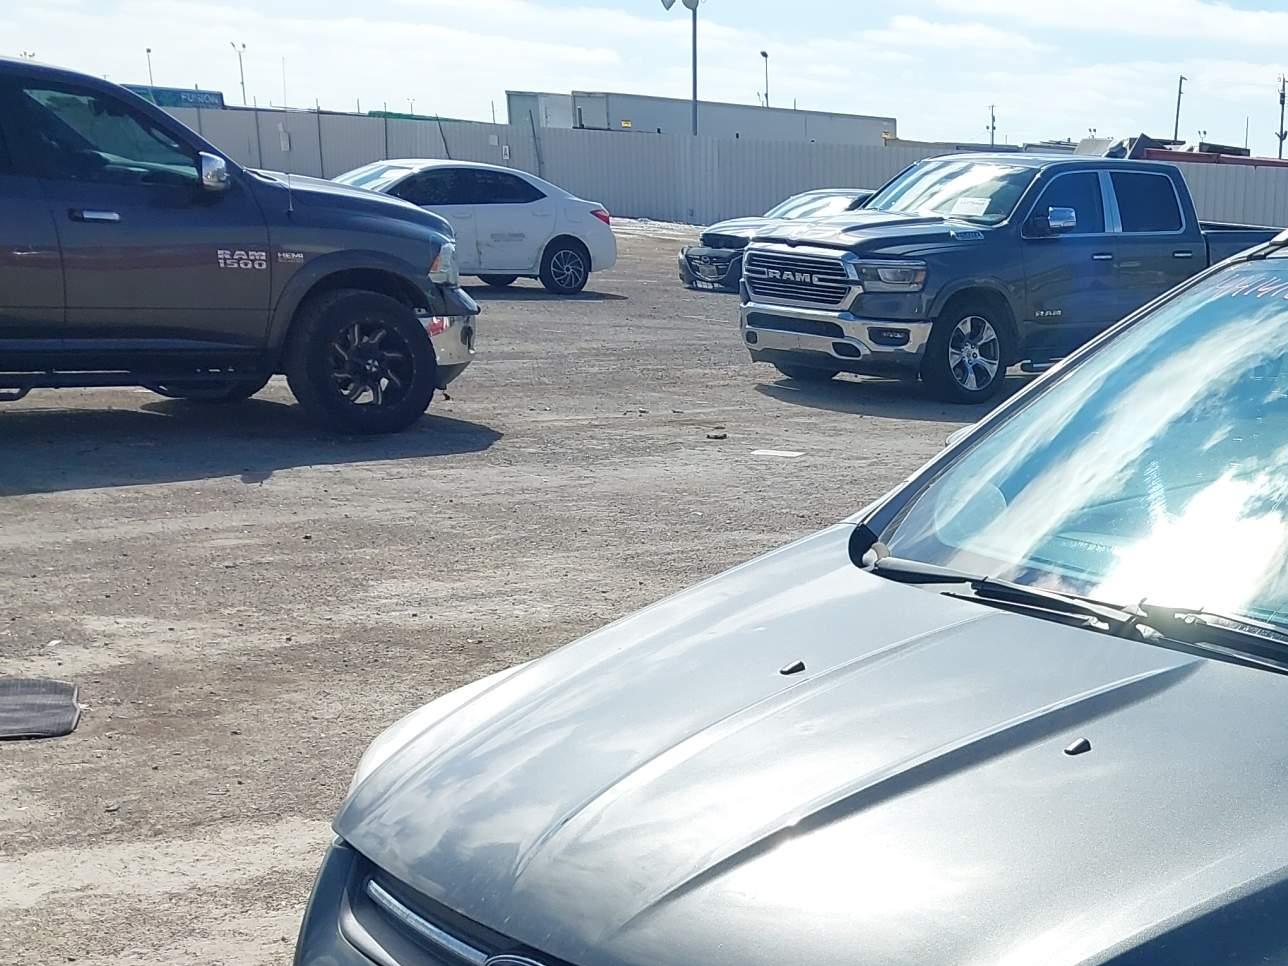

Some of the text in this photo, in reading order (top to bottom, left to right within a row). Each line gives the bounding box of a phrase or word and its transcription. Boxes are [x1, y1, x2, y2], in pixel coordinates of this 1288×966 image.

[217, 250, 266, 260] RAM
[218, 259, 267, 269] 1500
[768, 269, 811, 283] RAM
